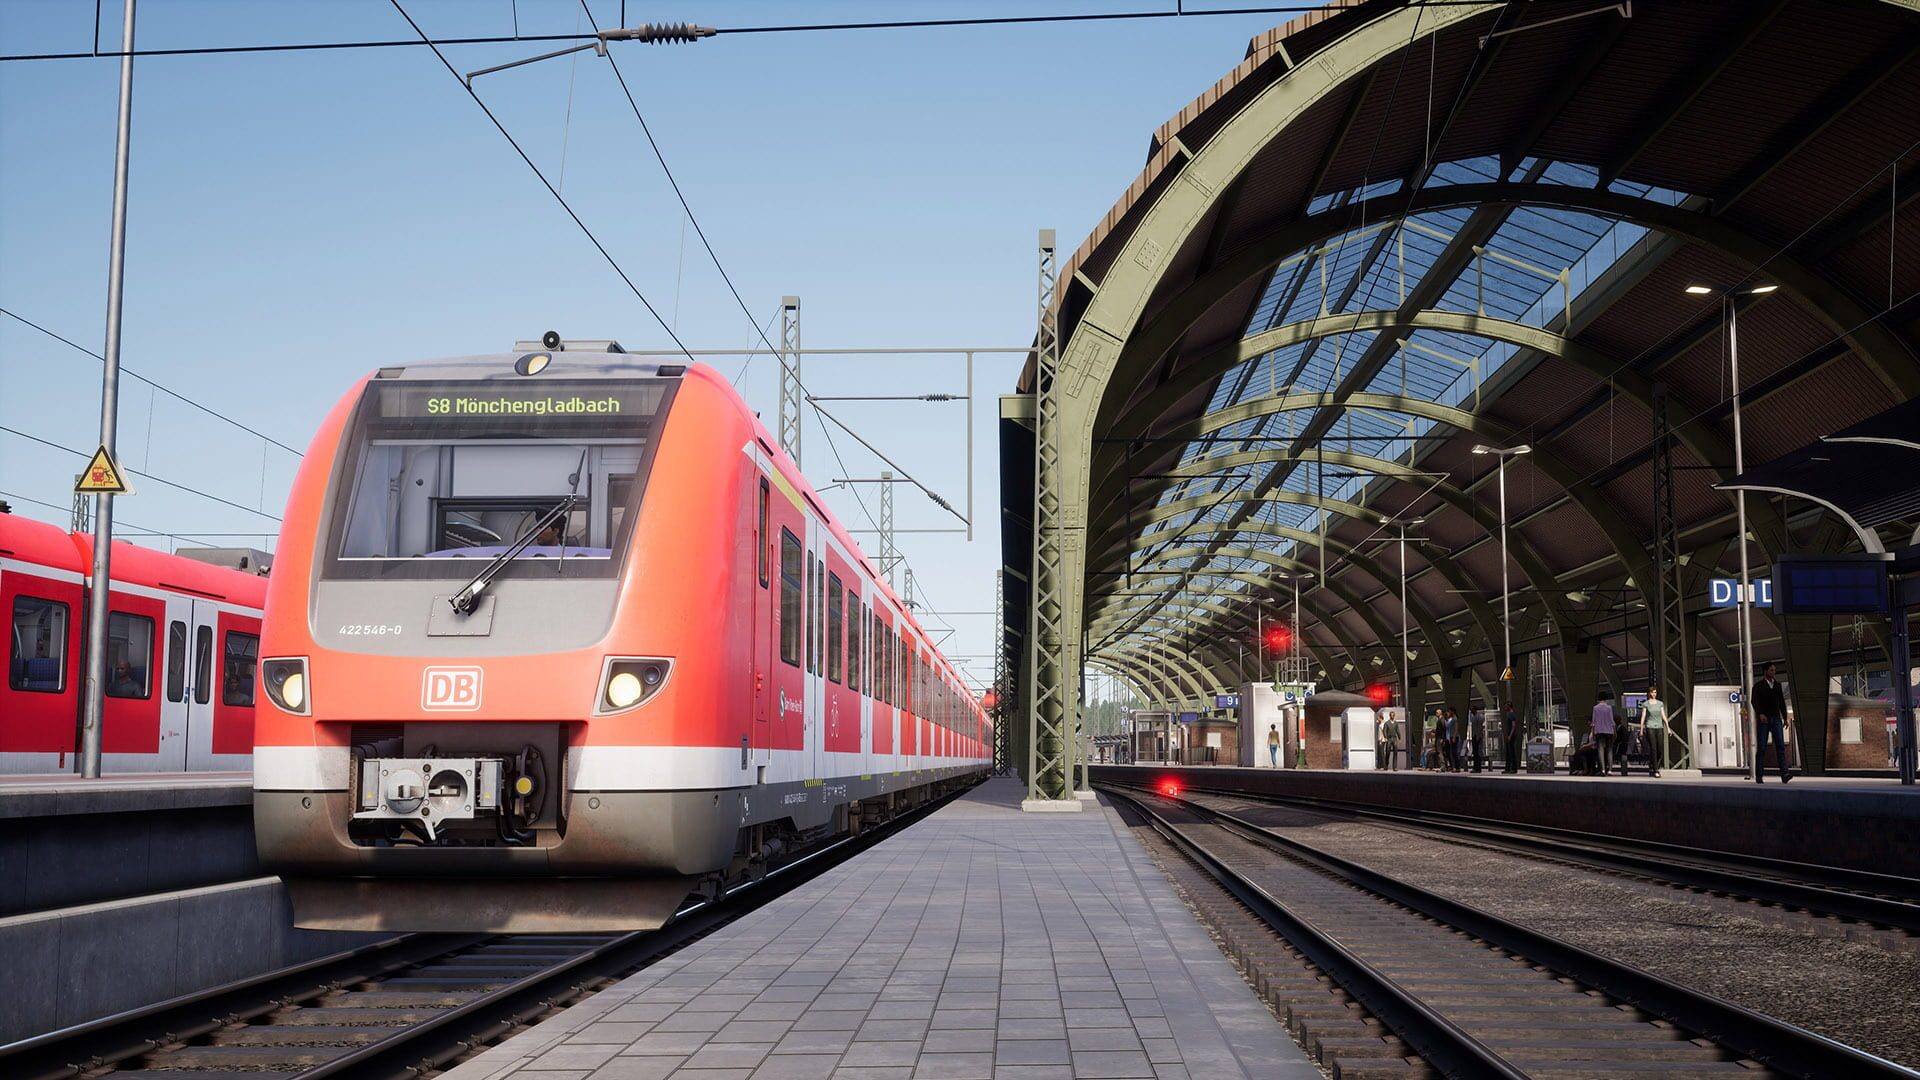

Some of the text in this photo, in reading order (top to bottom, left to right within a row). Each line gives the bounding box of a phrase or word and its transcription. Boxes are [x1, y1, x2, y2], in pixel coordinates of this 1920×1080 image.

[427, 397, 621, 415] S8 Mönchengladbach
[1712, 580, 1731, 603] D
[428, 673, 477, 704] DB
[1730, 693, 1738, 702] C
[1227, 696, 1233, 705] 9
